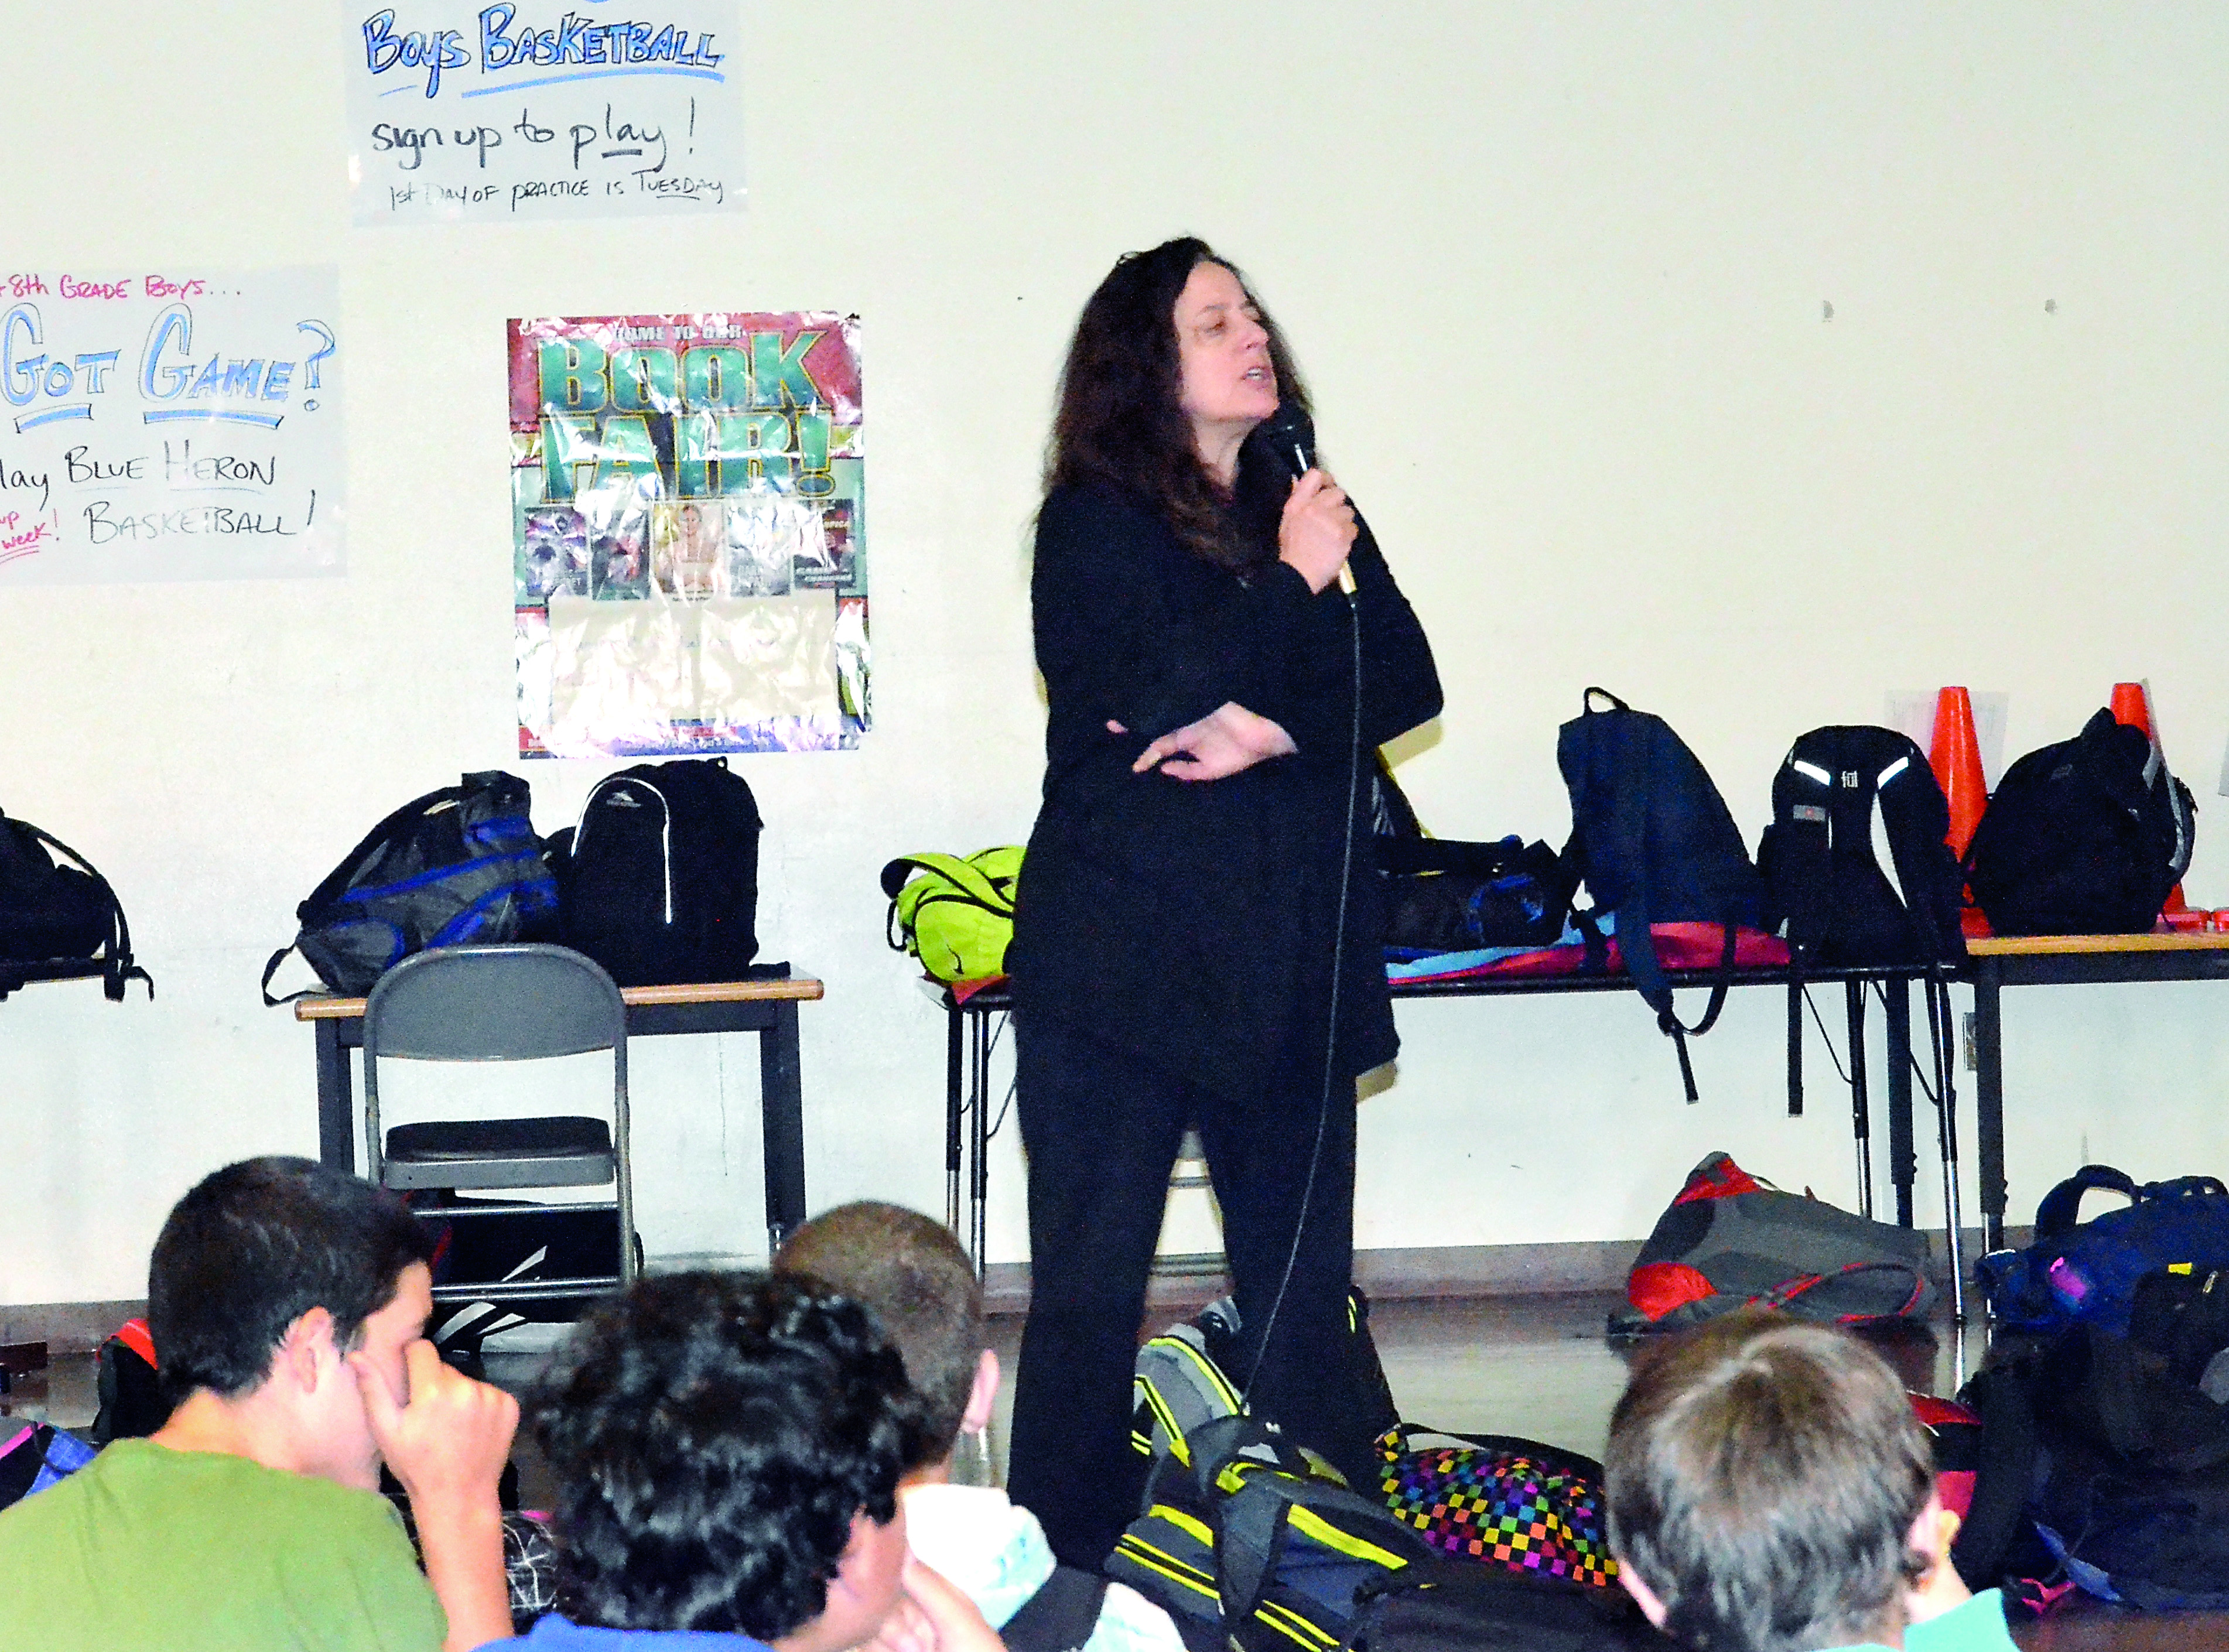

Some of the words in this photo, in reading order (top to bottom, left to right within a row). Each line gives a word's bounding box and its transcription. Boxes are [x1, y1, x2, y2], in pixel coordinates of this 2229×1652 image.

[371, 121, 443, 170] sign
[454, 124, 503, 168] up
[513, 108, 555, 143] to
[390, 185, 414, 210] 1st
[473, 185, 501, 203] OF
[60, 273, 132, 299] GRADE
[0, 302, 121, 406] GOT
[138, 302, 337, 412] GAME?
[536, 330, 834, 413] BOOK
[0, 459, 49, 512] lay
[64, 445, 149, 484] BLUE
[164, 439, 276, 485] HERON
[539, 409, 836, 504] FAIR!
